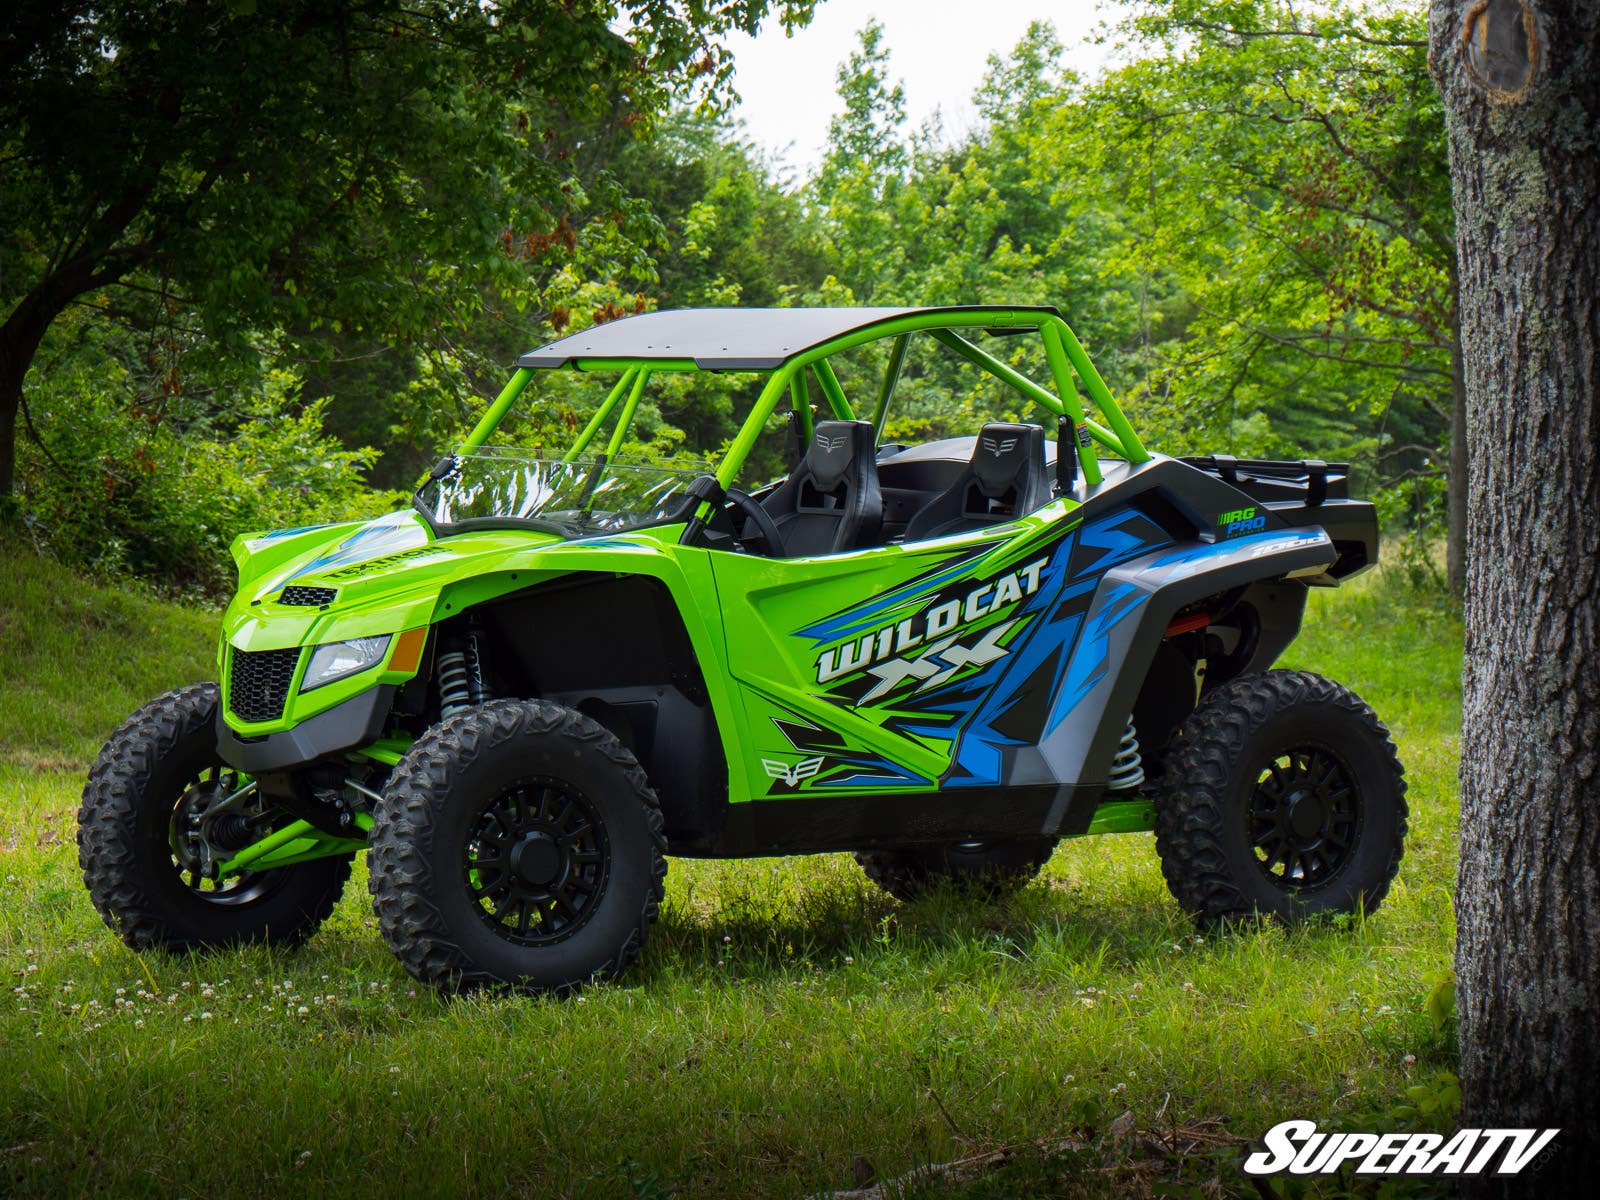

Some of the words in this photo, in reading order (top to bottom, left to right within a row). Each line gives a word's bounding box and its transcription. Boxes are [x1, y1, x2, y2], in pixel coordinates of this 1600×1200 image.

[1226, 516, 1266, 534] PRO
[815, 556, 1050, 685] WILDCAT
[856, 616, 1021, 708] XX
